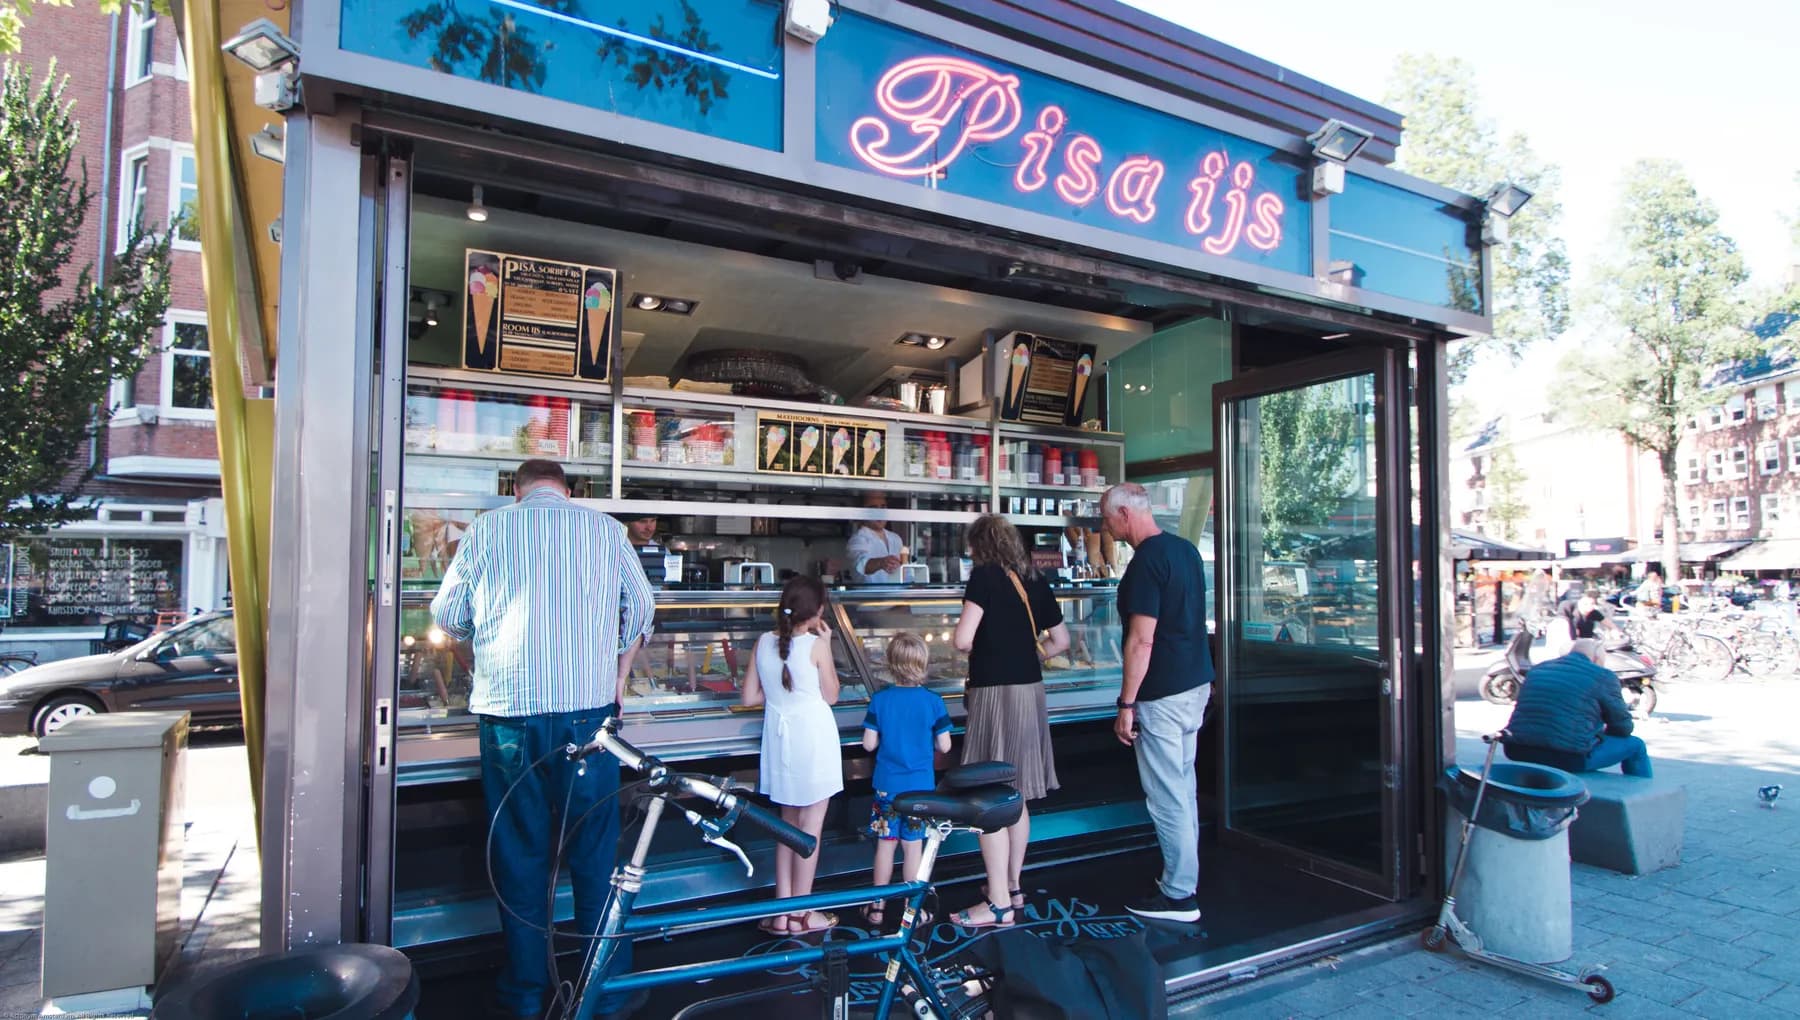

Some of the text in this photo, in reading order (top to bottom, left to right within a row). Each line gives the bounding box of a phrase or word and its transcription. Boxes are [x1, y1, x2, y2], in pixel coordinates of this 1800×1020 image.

[849, 55, 1286, 257] Pisa ijs
[505, 260, 536, 279] PISA
[502, 323, 529, 333] ROOM
